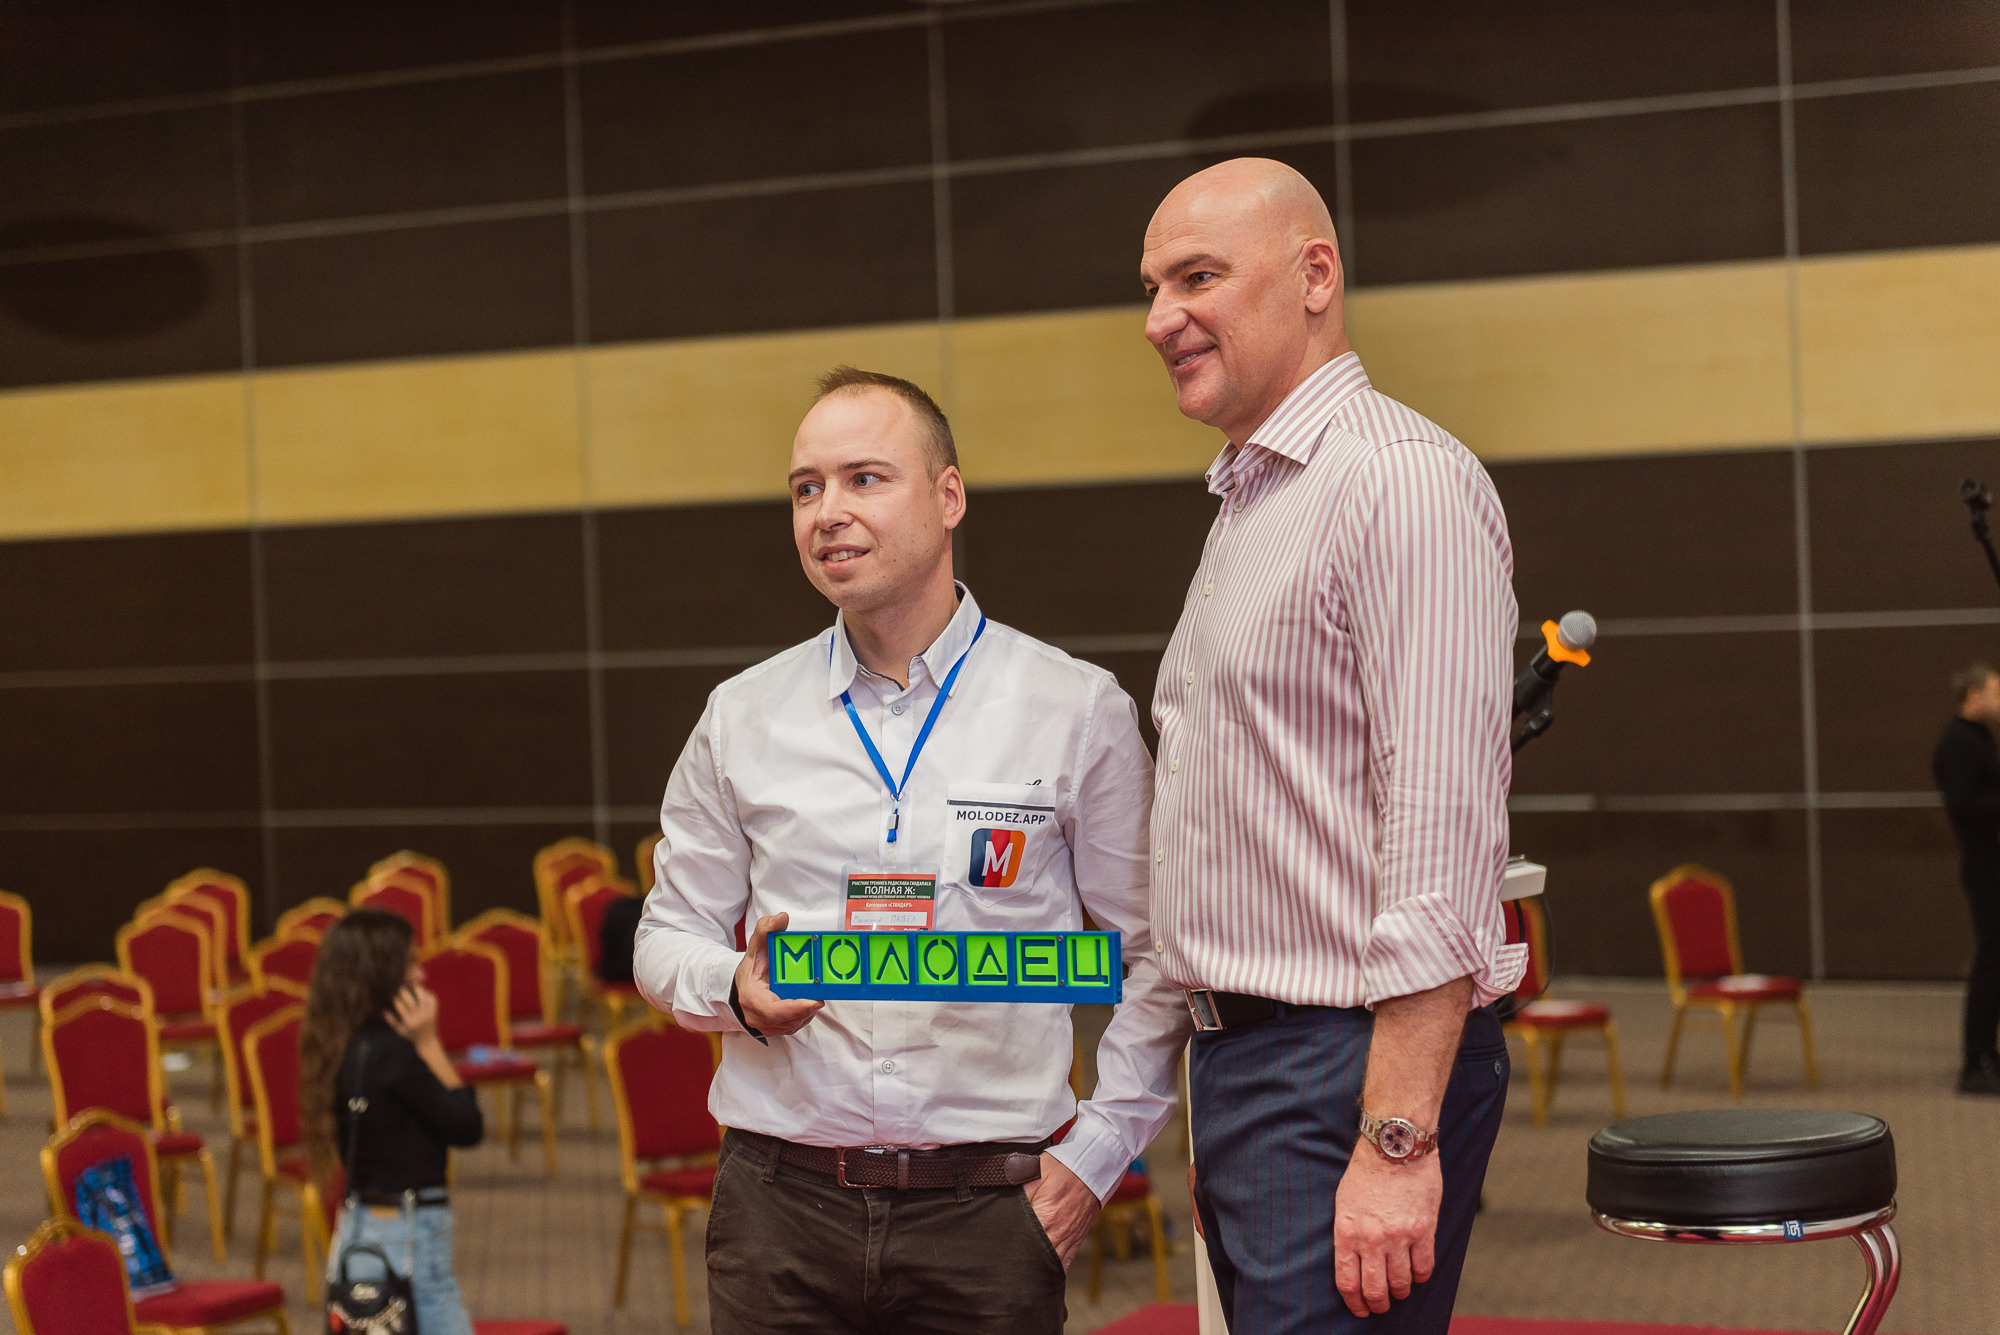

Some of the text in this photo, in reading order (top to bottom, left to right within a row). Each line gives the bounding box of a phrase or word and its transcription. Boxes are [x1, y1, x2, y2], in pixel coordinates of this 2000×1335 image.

[956, 810, 1046, 825] MOLODEZ.APP
[981, 840, 1014, 877] M
[864, 886, 916, 895] ПОЛНАЯ Ж:
[780, 938, 1109, 985] МОЛОДЕЦ
